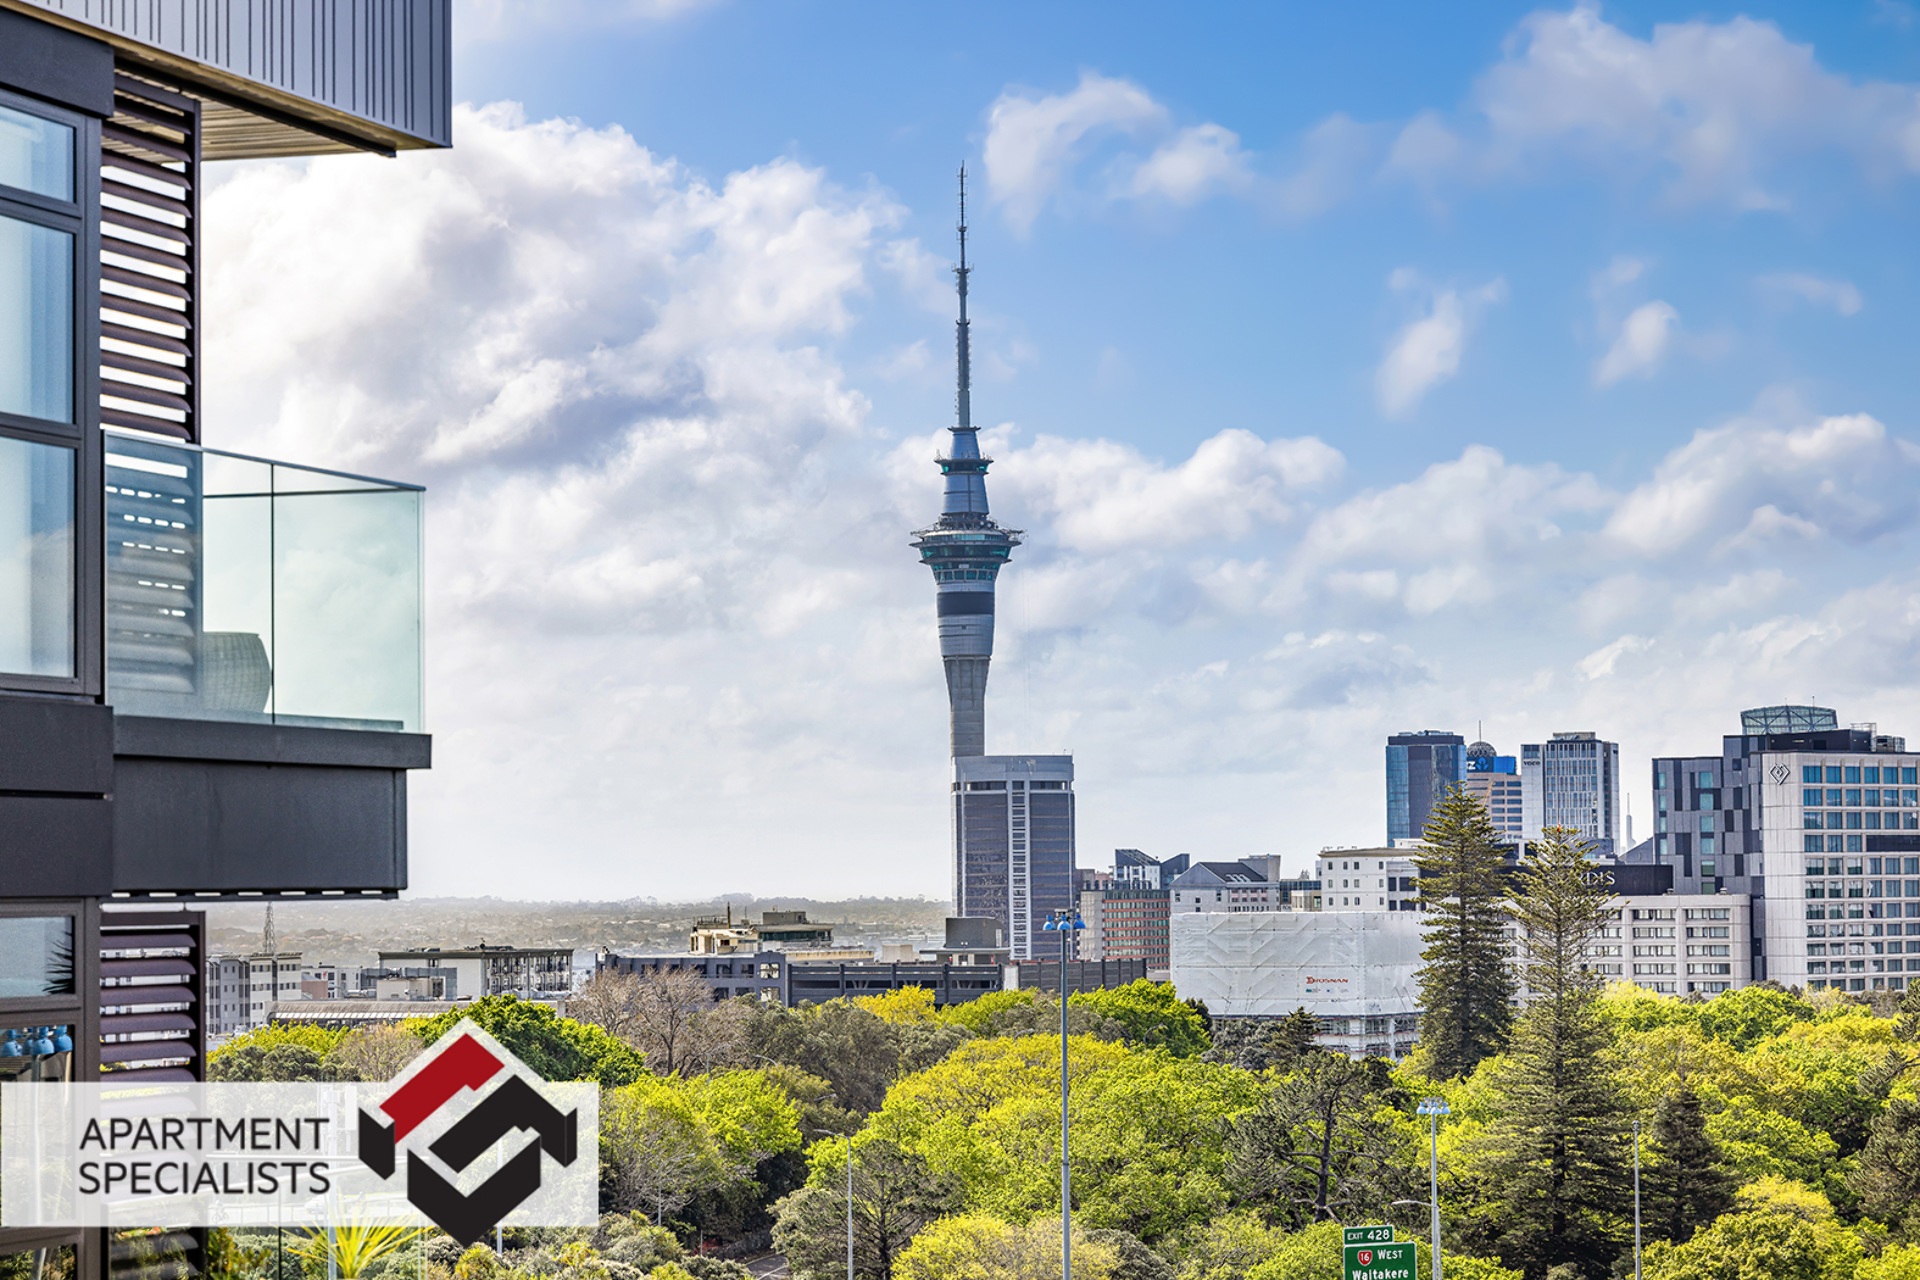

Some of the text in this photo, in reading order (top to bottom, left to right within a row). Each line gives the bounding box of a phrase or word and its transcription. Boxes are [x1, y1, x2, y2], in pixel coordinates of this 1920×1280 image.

[1347, 1229, 1390, 1240] EXIT 428
[1360, 1249, 1403, 1261] 16 WEST
[1352, 1268, 1409, 1280] Waitakere
